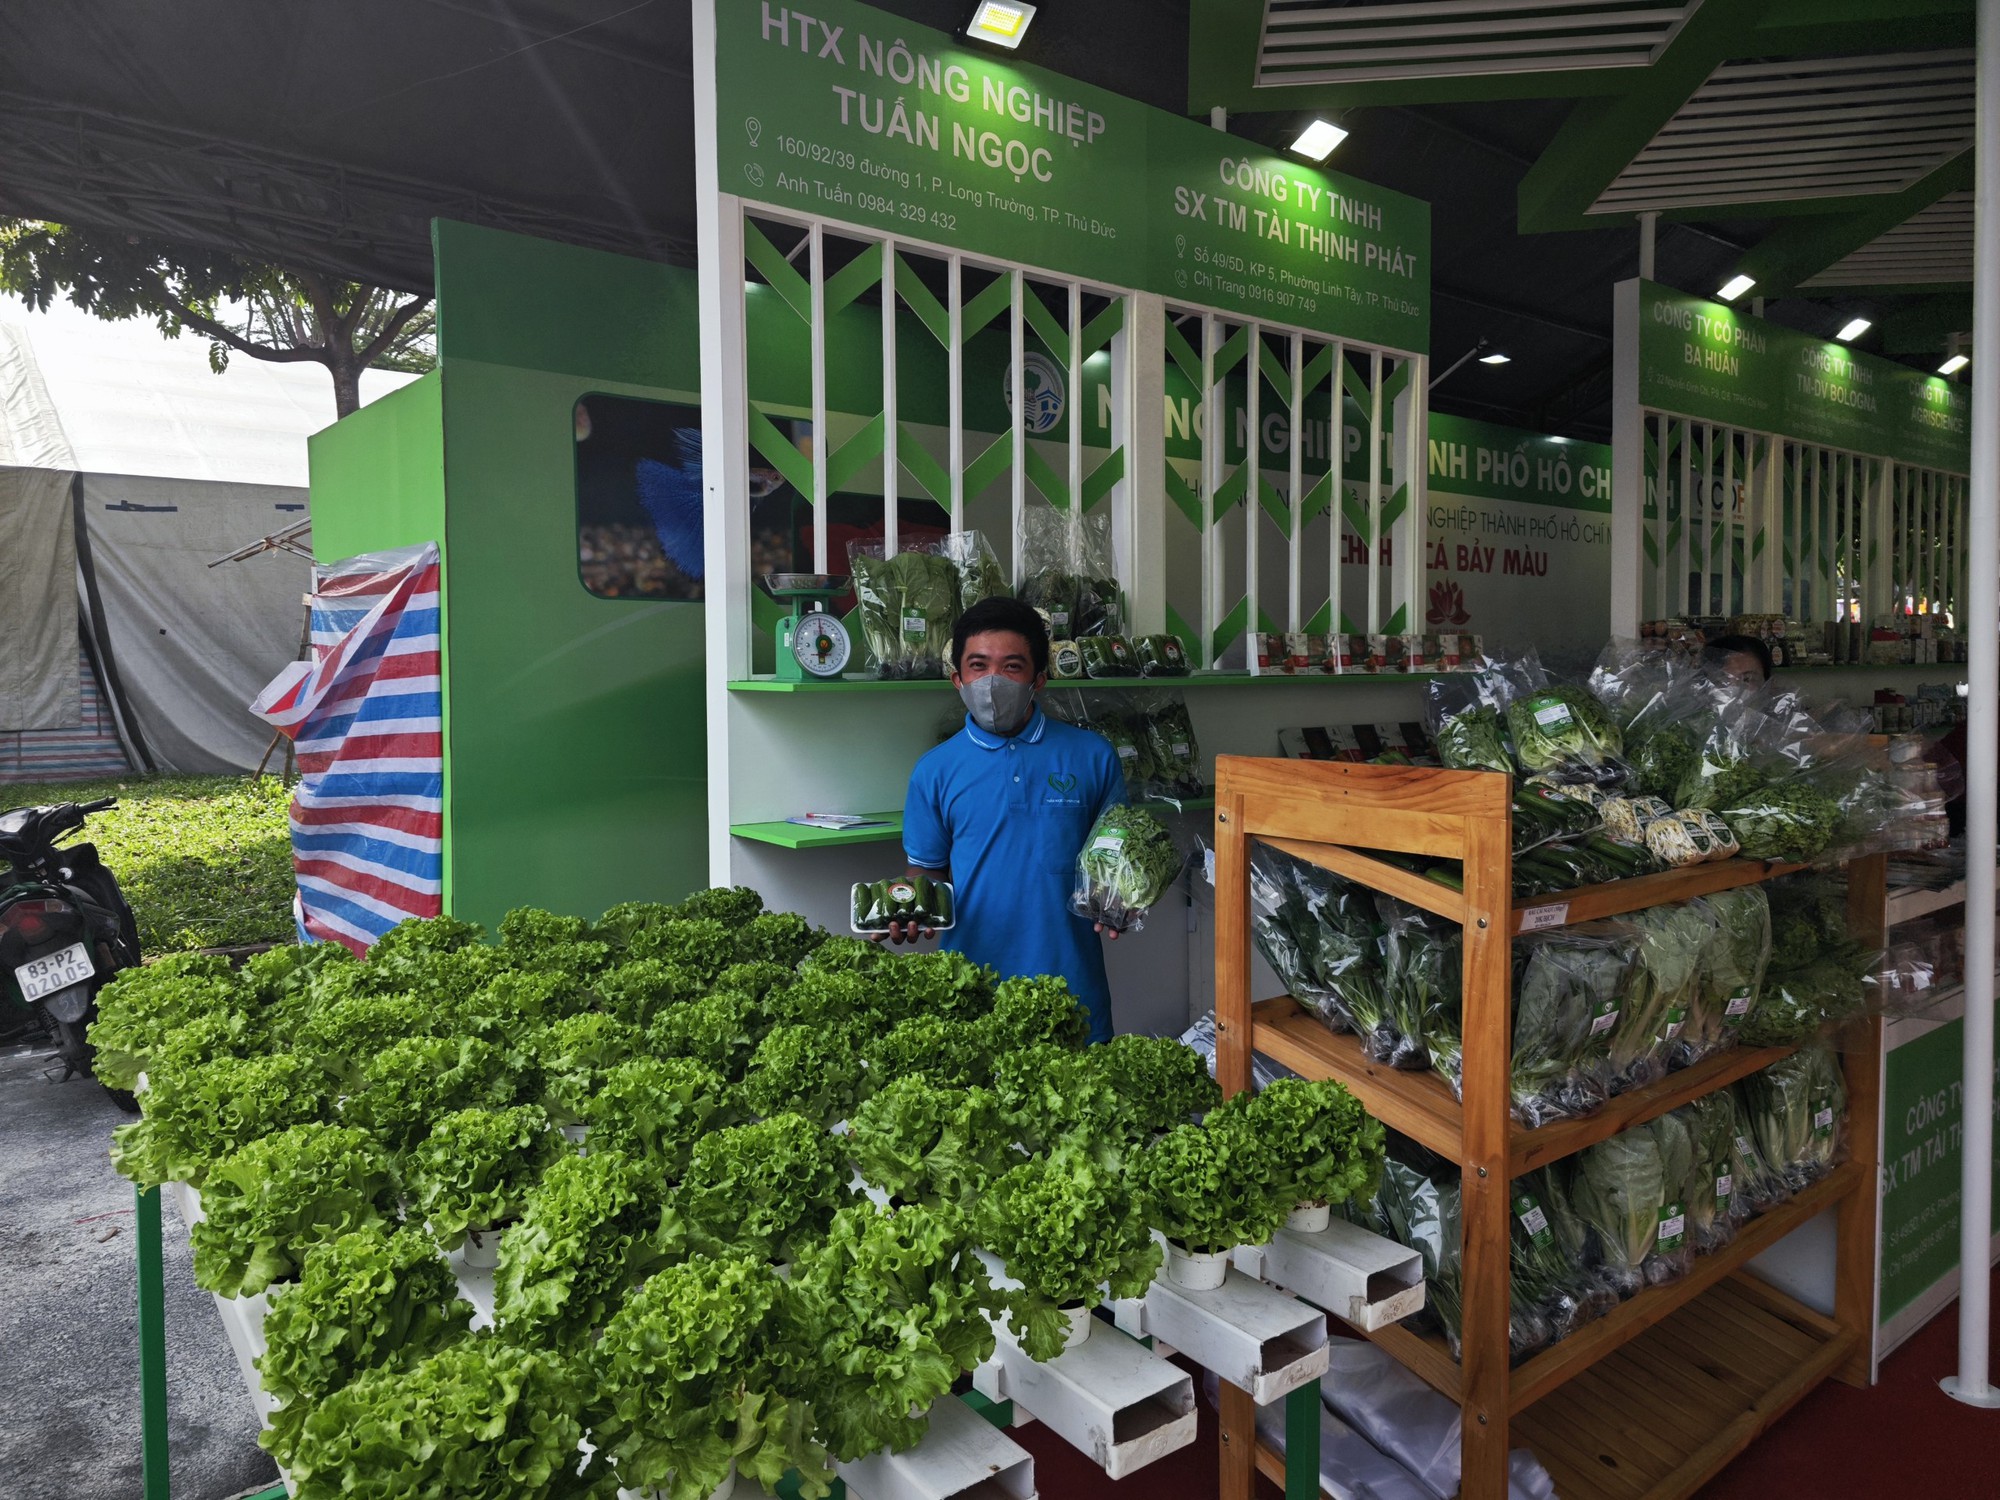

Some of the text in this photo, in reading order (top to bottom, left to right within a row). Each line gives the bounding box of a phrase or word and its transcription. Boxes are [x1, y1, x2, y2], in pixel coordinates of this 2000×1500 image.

[761, 2, 1106, 147] HTX NÔNG NGHIỆP
[832, 85, 1053, 184] TUẤN NGỌC
[776, 172, 956, 230] Anh Tuấn 0984 329 432
[777, 135, 1116, 239] 160/92/39 đường 1, P. Long Trường, TP. Thủ Đức
[1219, 157, 1381, 232] CÔNG TY TNHH
[1174, 186, 1416, 279] SX TM TÀI THỊNH PHÁT
[1194, 246, 1420, 316] Số 49/5D, KP 5, Phường Linh Tây, TP. Thủ Đức
[1194, 271, 1316, 313] Chị Trang 0916 907 749
[1654, 300, 1692, 331] CÔNG
[1695, 314, 1711, 337] TY
[1684, 343, 1739, 377] BA HUÂN
[1801, 347, 1873, 386] CÔNG TY TNHH
[1797, 373, 1828, 400] TM-DV
[1831, 383, 1877, 414] BOLOGNA
[1909, 377, 1966, 409] CÔNG TY TNHH
[1911, 406, 1964, 434] AGRISCIENCE
[1476, 442, 1530, 489] PHỐ
[1538, 446, 1572, 495] HỒ
[1481, 510, 1526, 537] THÀNH
[1530, 514, 1558, 540] PHỐ
[1561, 515, 1580, 543] HỒ
[1583, 521, 1603, 544] CHÍ
[1457, 537, 1495, 574] BẢY
[1503, 544, 1548, 577] MÀU
[26, 961, 89, 998] 020.05
[28, 949, 76, 979] 83-P2
[1906, 1089, 1946, 1136] CÔNG
[1881, 1160, 1898, 1197] SX
[1901, 1146, 1921, 1182] TM
[1925, 1128, 1946, 1167] TÀI
